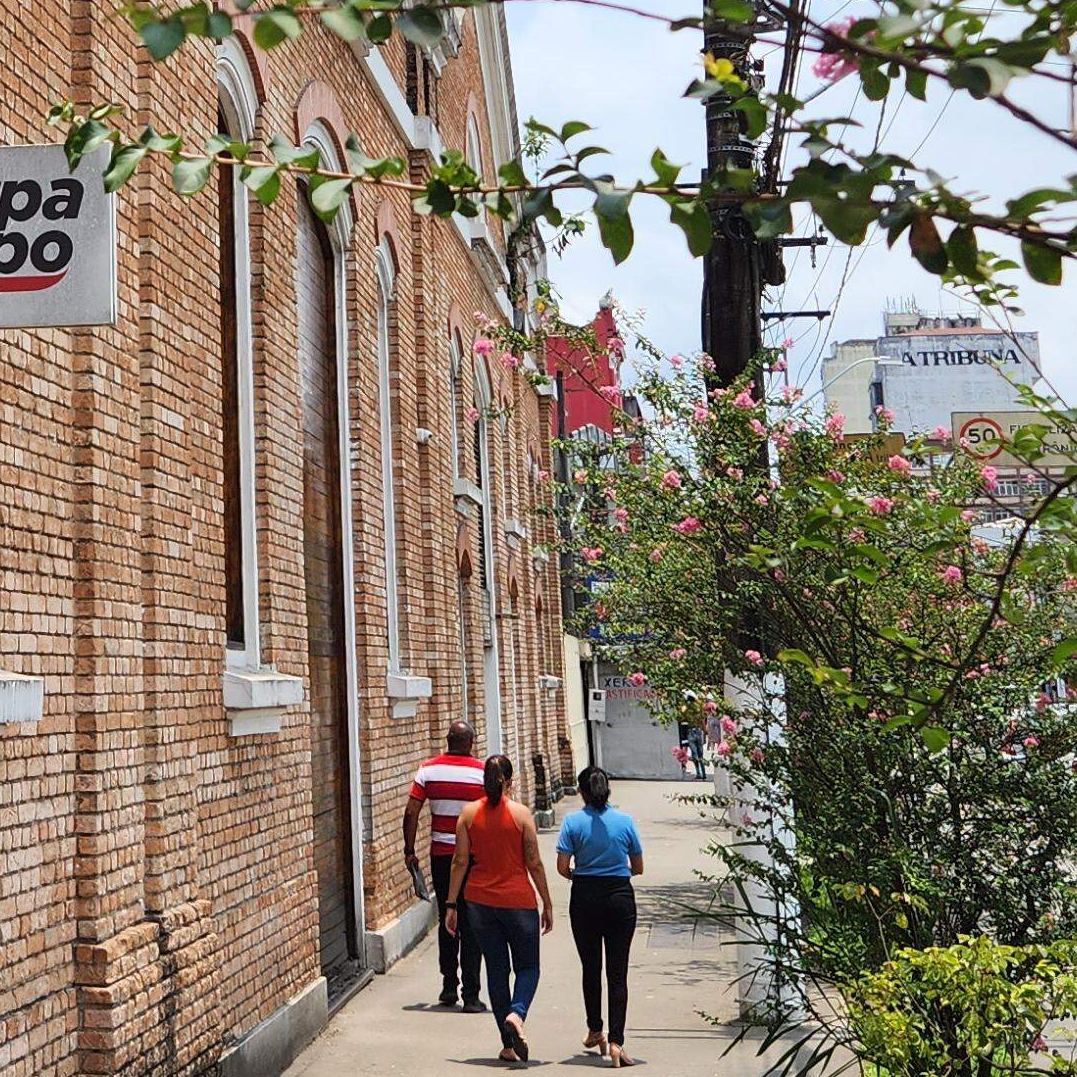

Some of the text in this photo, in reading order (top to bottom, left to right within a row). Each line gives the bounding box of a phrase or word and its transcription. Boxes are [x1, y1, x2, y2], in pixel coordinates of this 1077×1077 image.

[902, 349, 1022, 366] A TRIBUNA
[968, 428, 996, 444] 50
